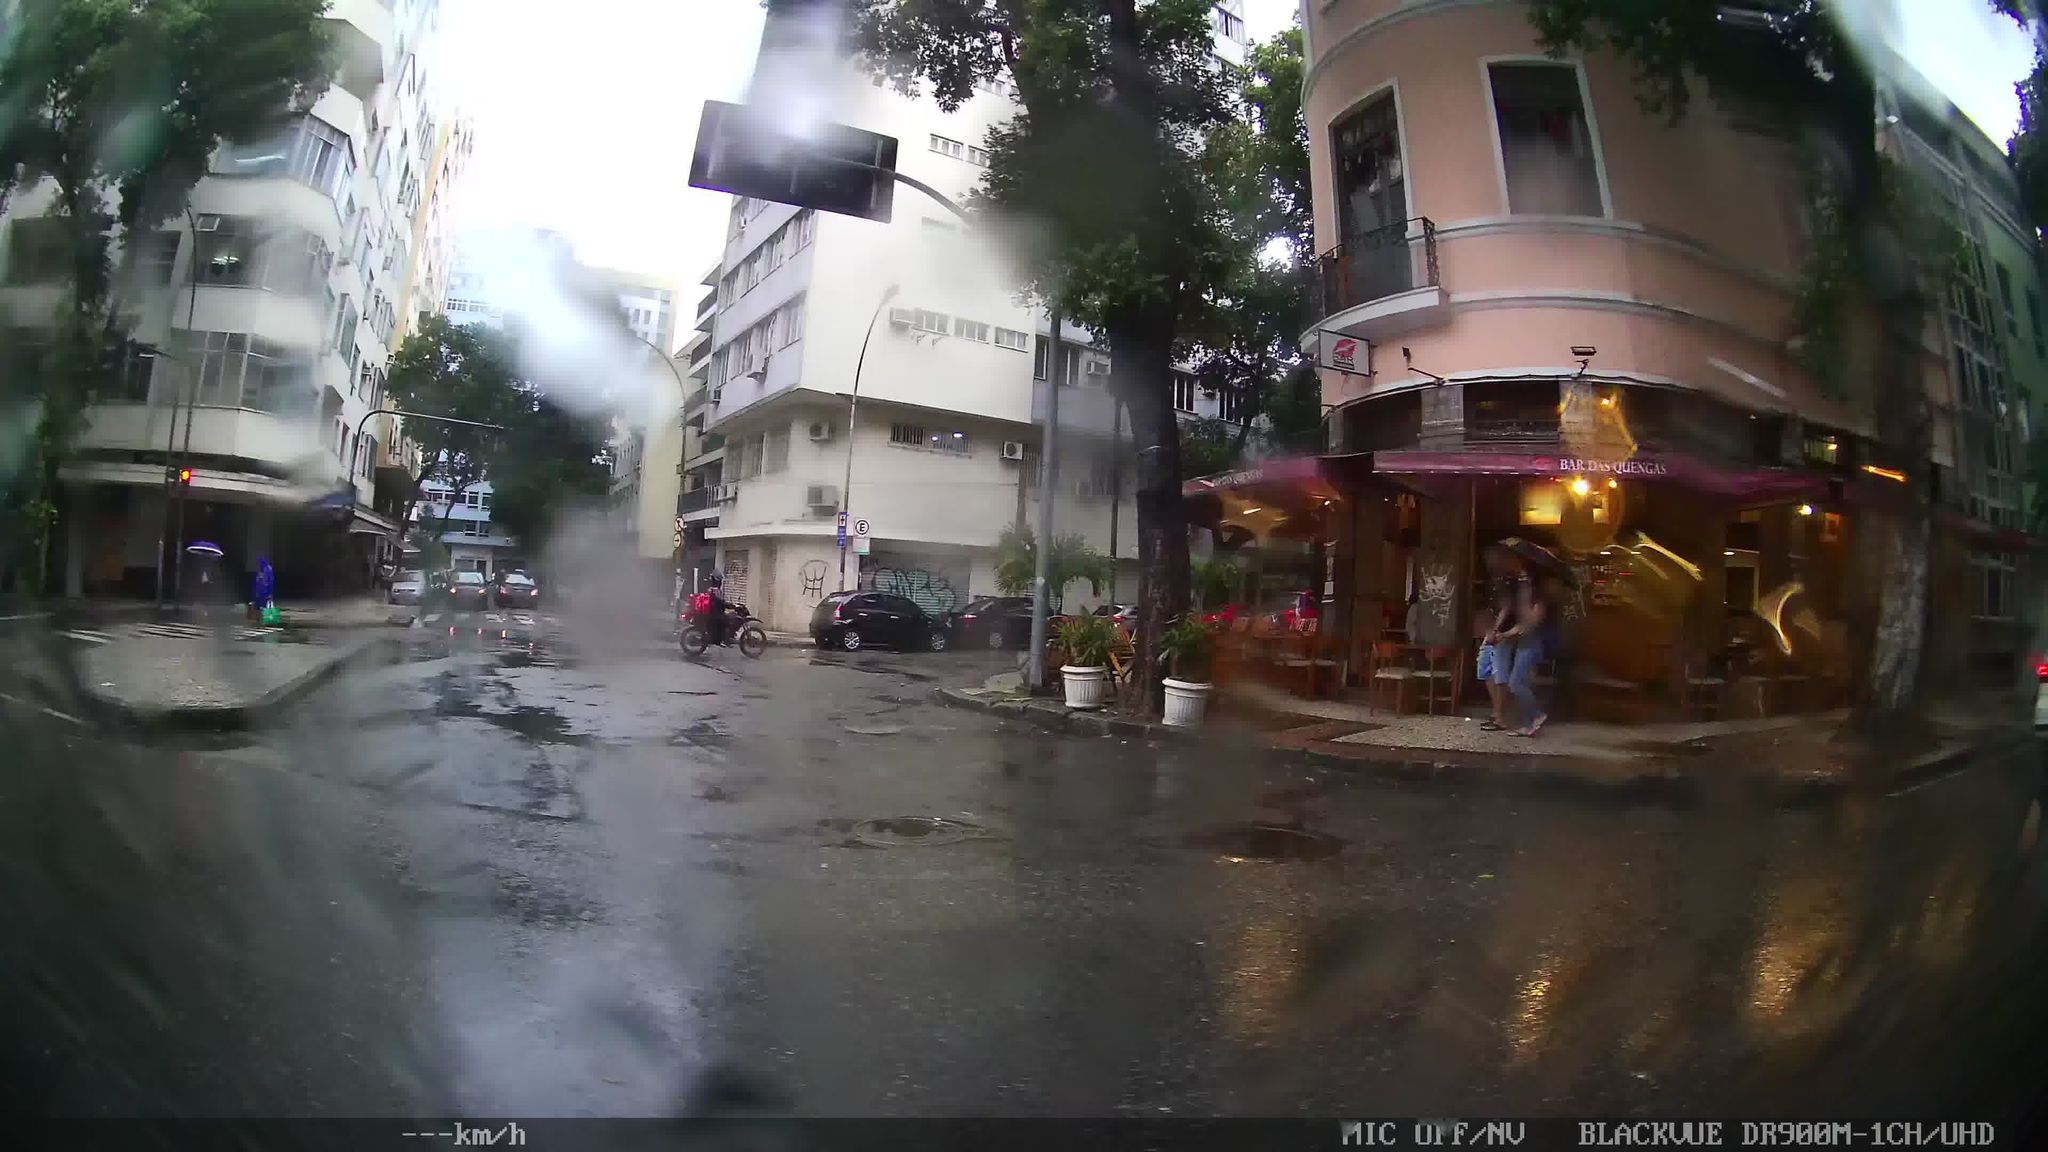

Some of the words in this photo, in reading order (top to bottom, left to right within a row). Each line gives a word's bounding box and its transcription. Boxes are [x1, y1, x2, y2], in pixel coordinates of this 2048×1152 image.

[1559, 458, 1585, 471] BAR
[1588, 459, 1611, 472] DAS
[1613, 460, 1669, 475] QUENGAS
